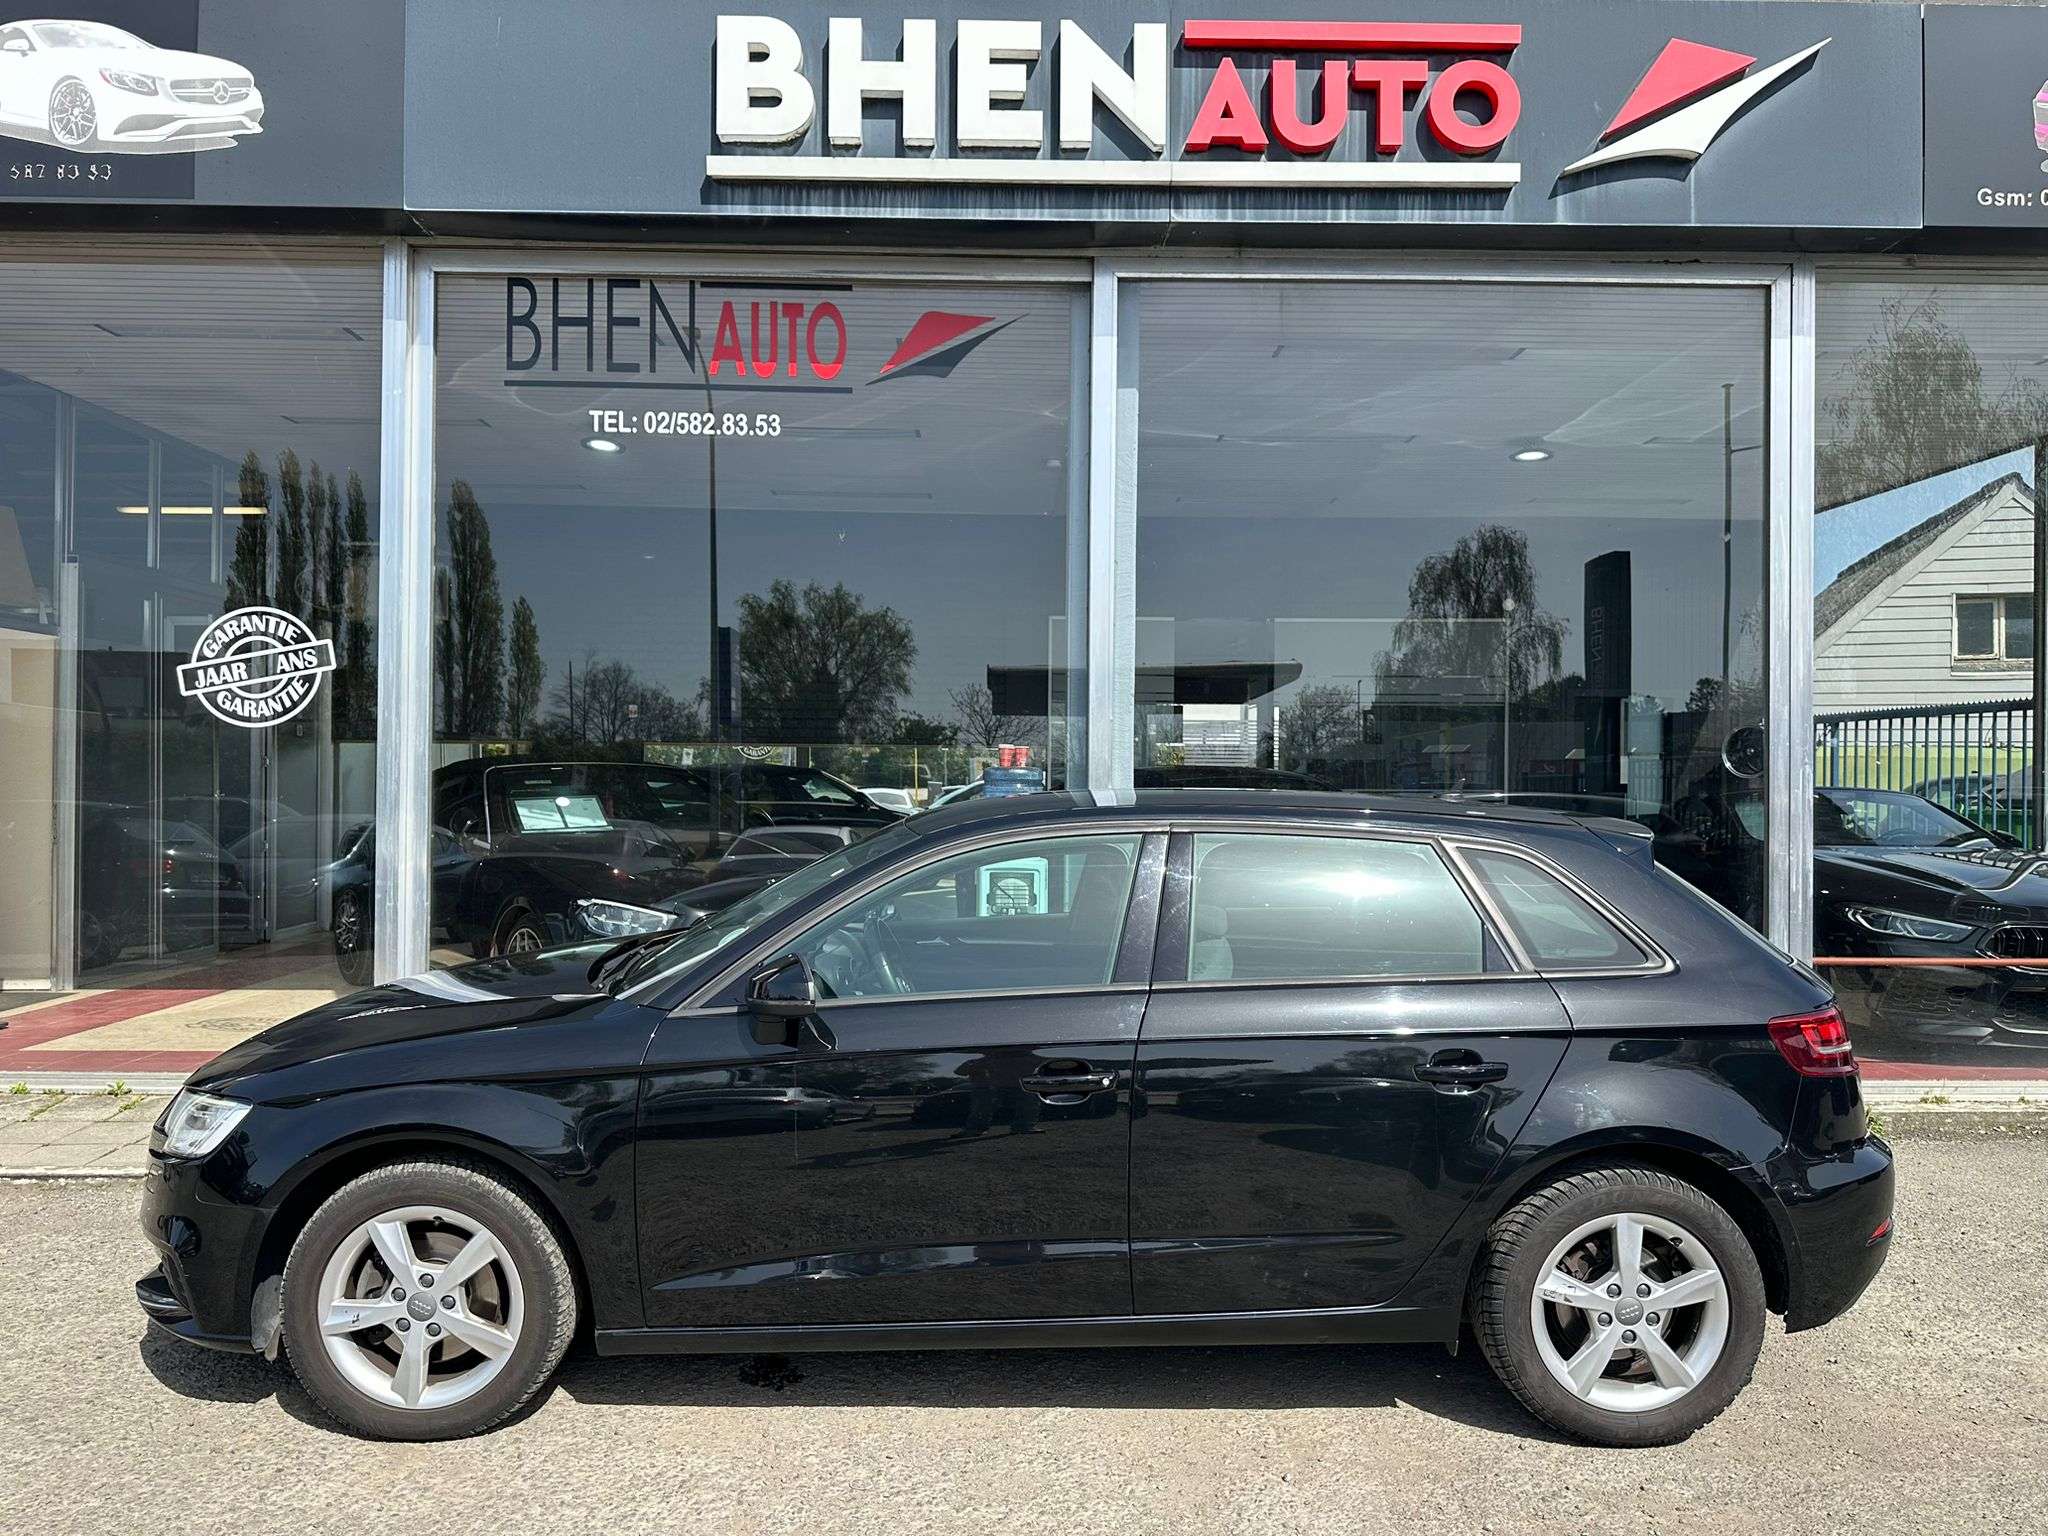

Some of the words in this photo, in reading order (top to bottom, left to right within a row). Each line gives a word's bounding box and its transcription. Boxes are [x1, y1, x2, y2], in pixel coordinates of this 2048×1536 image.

[715, 14, 1167, 153] BHEN
[1186, 56, 1522, 155] AUTO
[1976, 187, 2033, 206] Gsm:
[507, 277, 696, 374] BHEN
[709, 299, 847, 381] AUTO
[588, 410, 638, 435] TEL:
[643, 411, 782, 437] 02/582.83.53
[202, 614, 301, 658] GARANTIE
[194, 661, 249, 689] JAAR
[276, 648, 319, 674] ANS
[216, 676, 310, 719] GARANTIE
